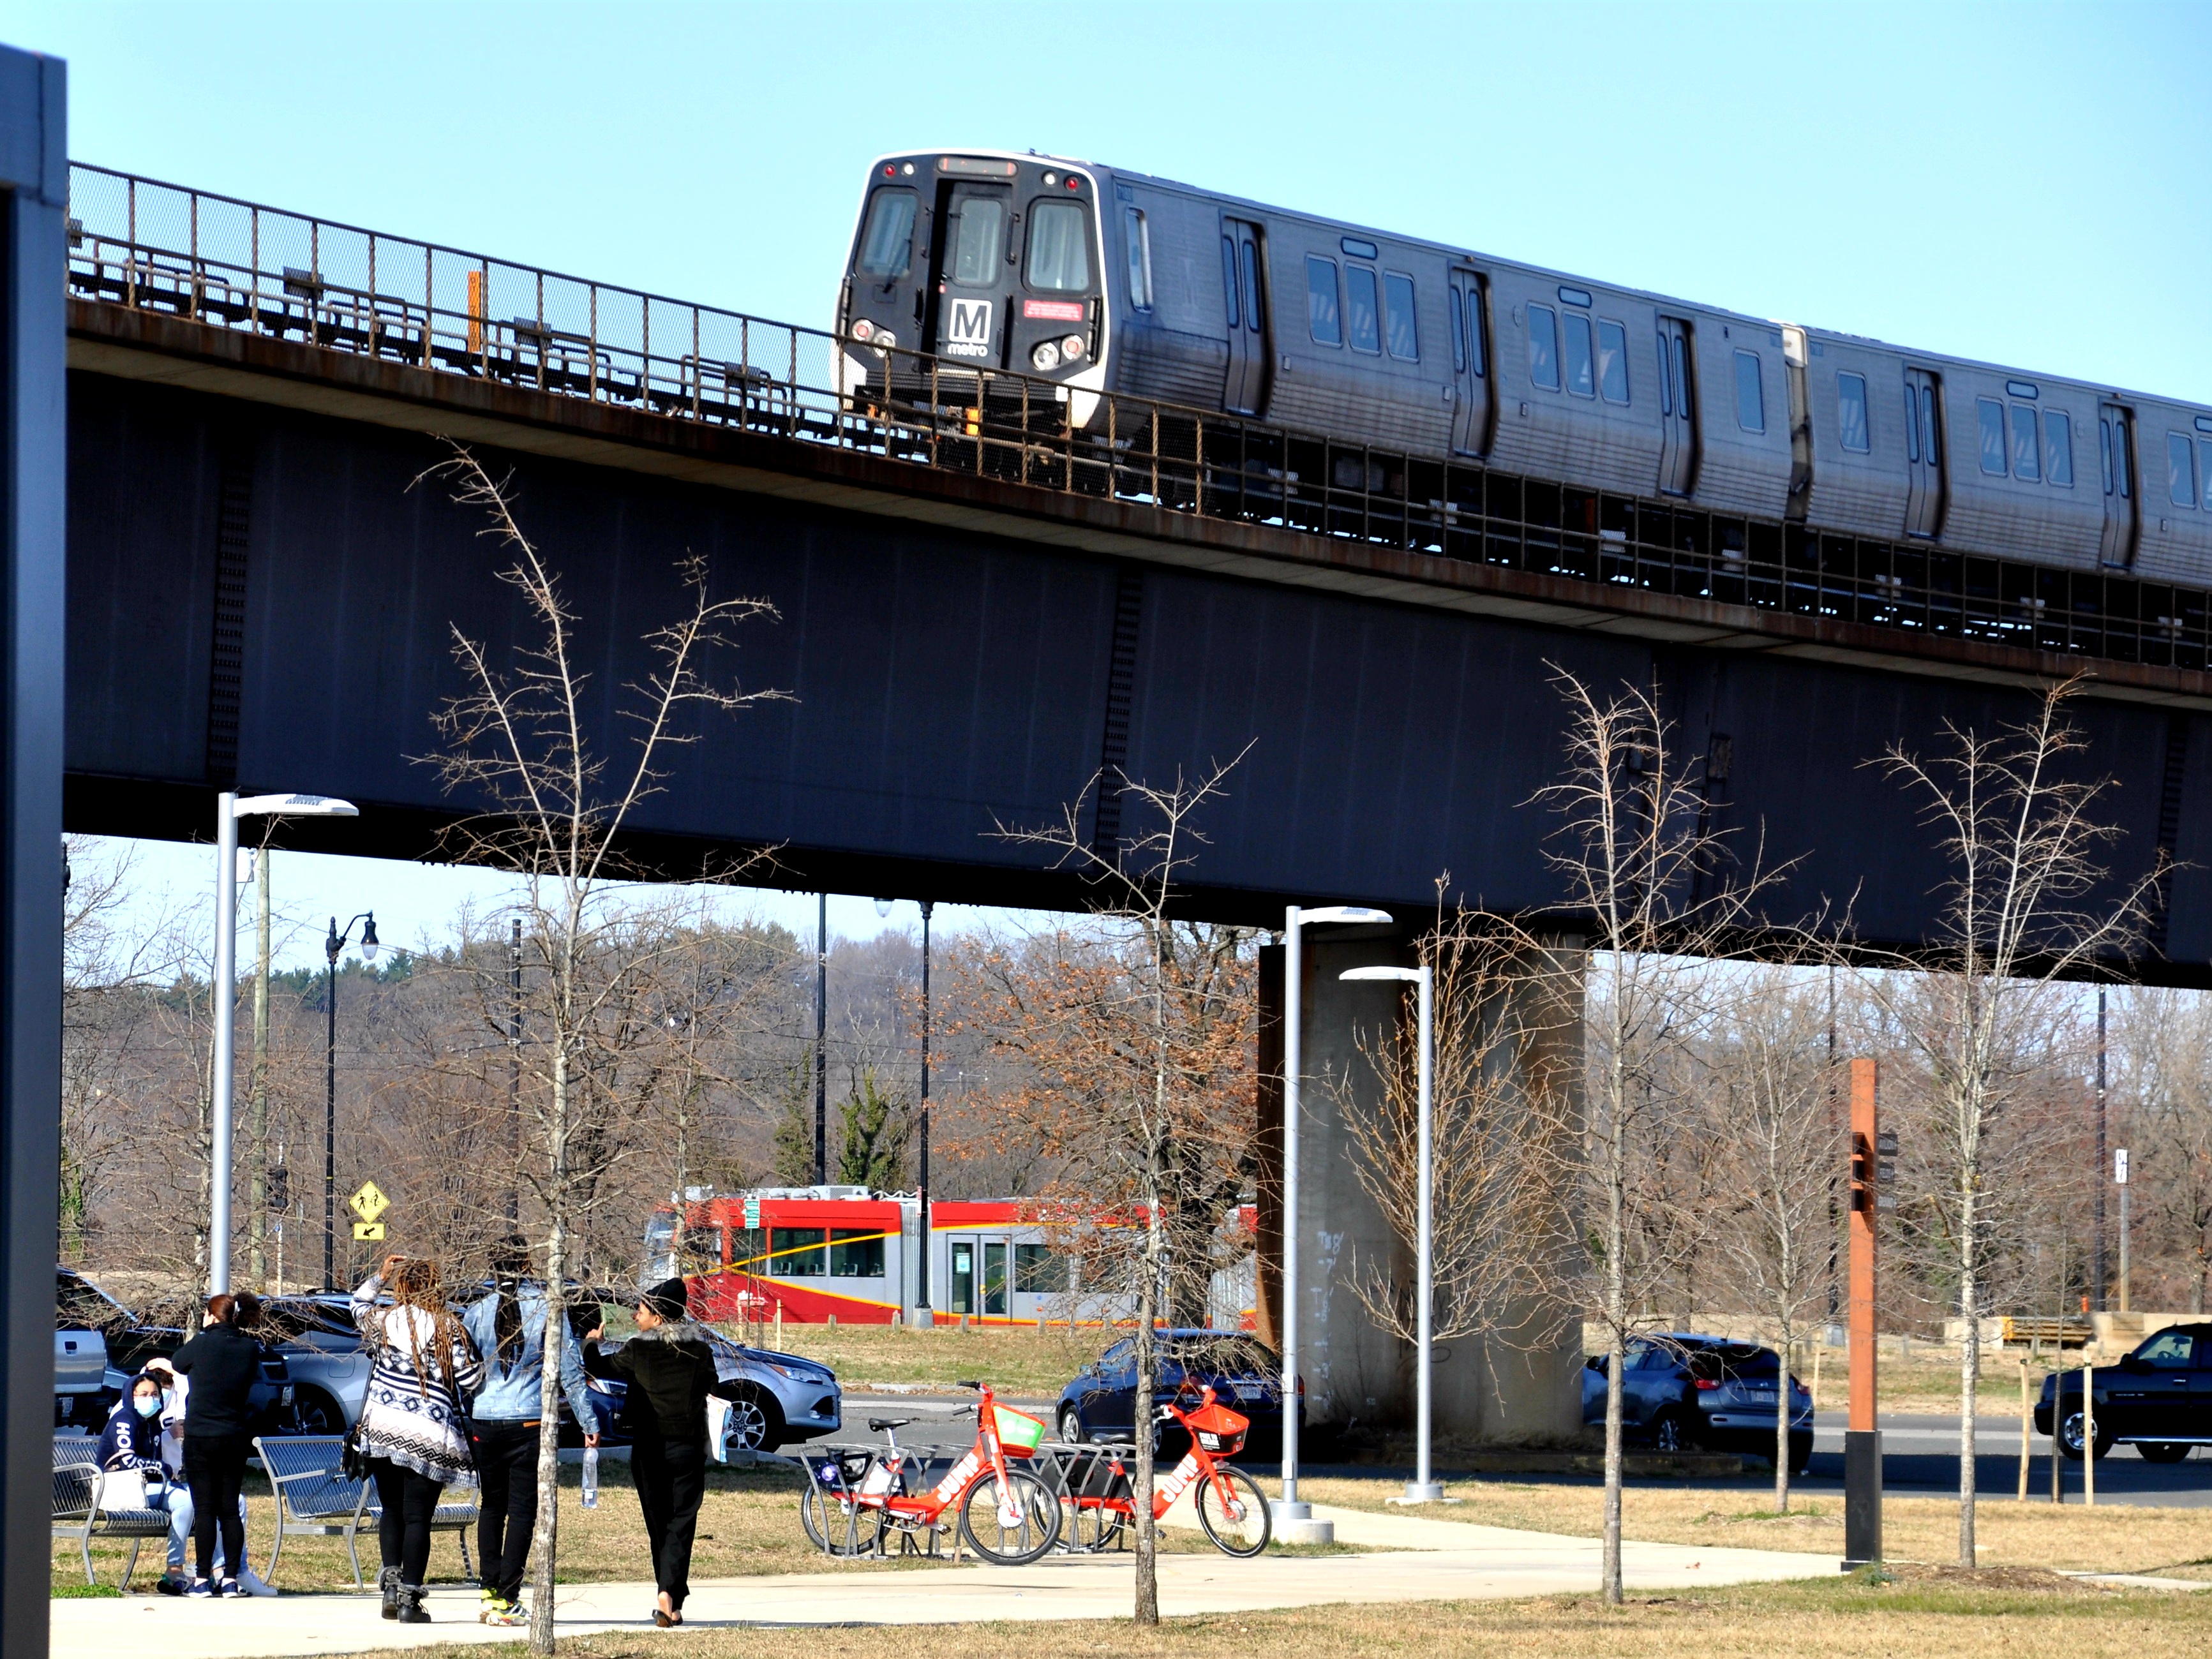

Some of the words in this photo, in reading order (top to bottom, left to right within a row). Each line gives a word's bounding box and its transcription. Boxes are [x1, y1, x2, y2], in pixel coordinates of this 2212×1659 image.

[953, 303, 988, 339] M
[947, 343, 988, 357] metro
[937, 1452, 980, 1503] JUMP
[1160, 1453, 1200, 1503] JUMP
